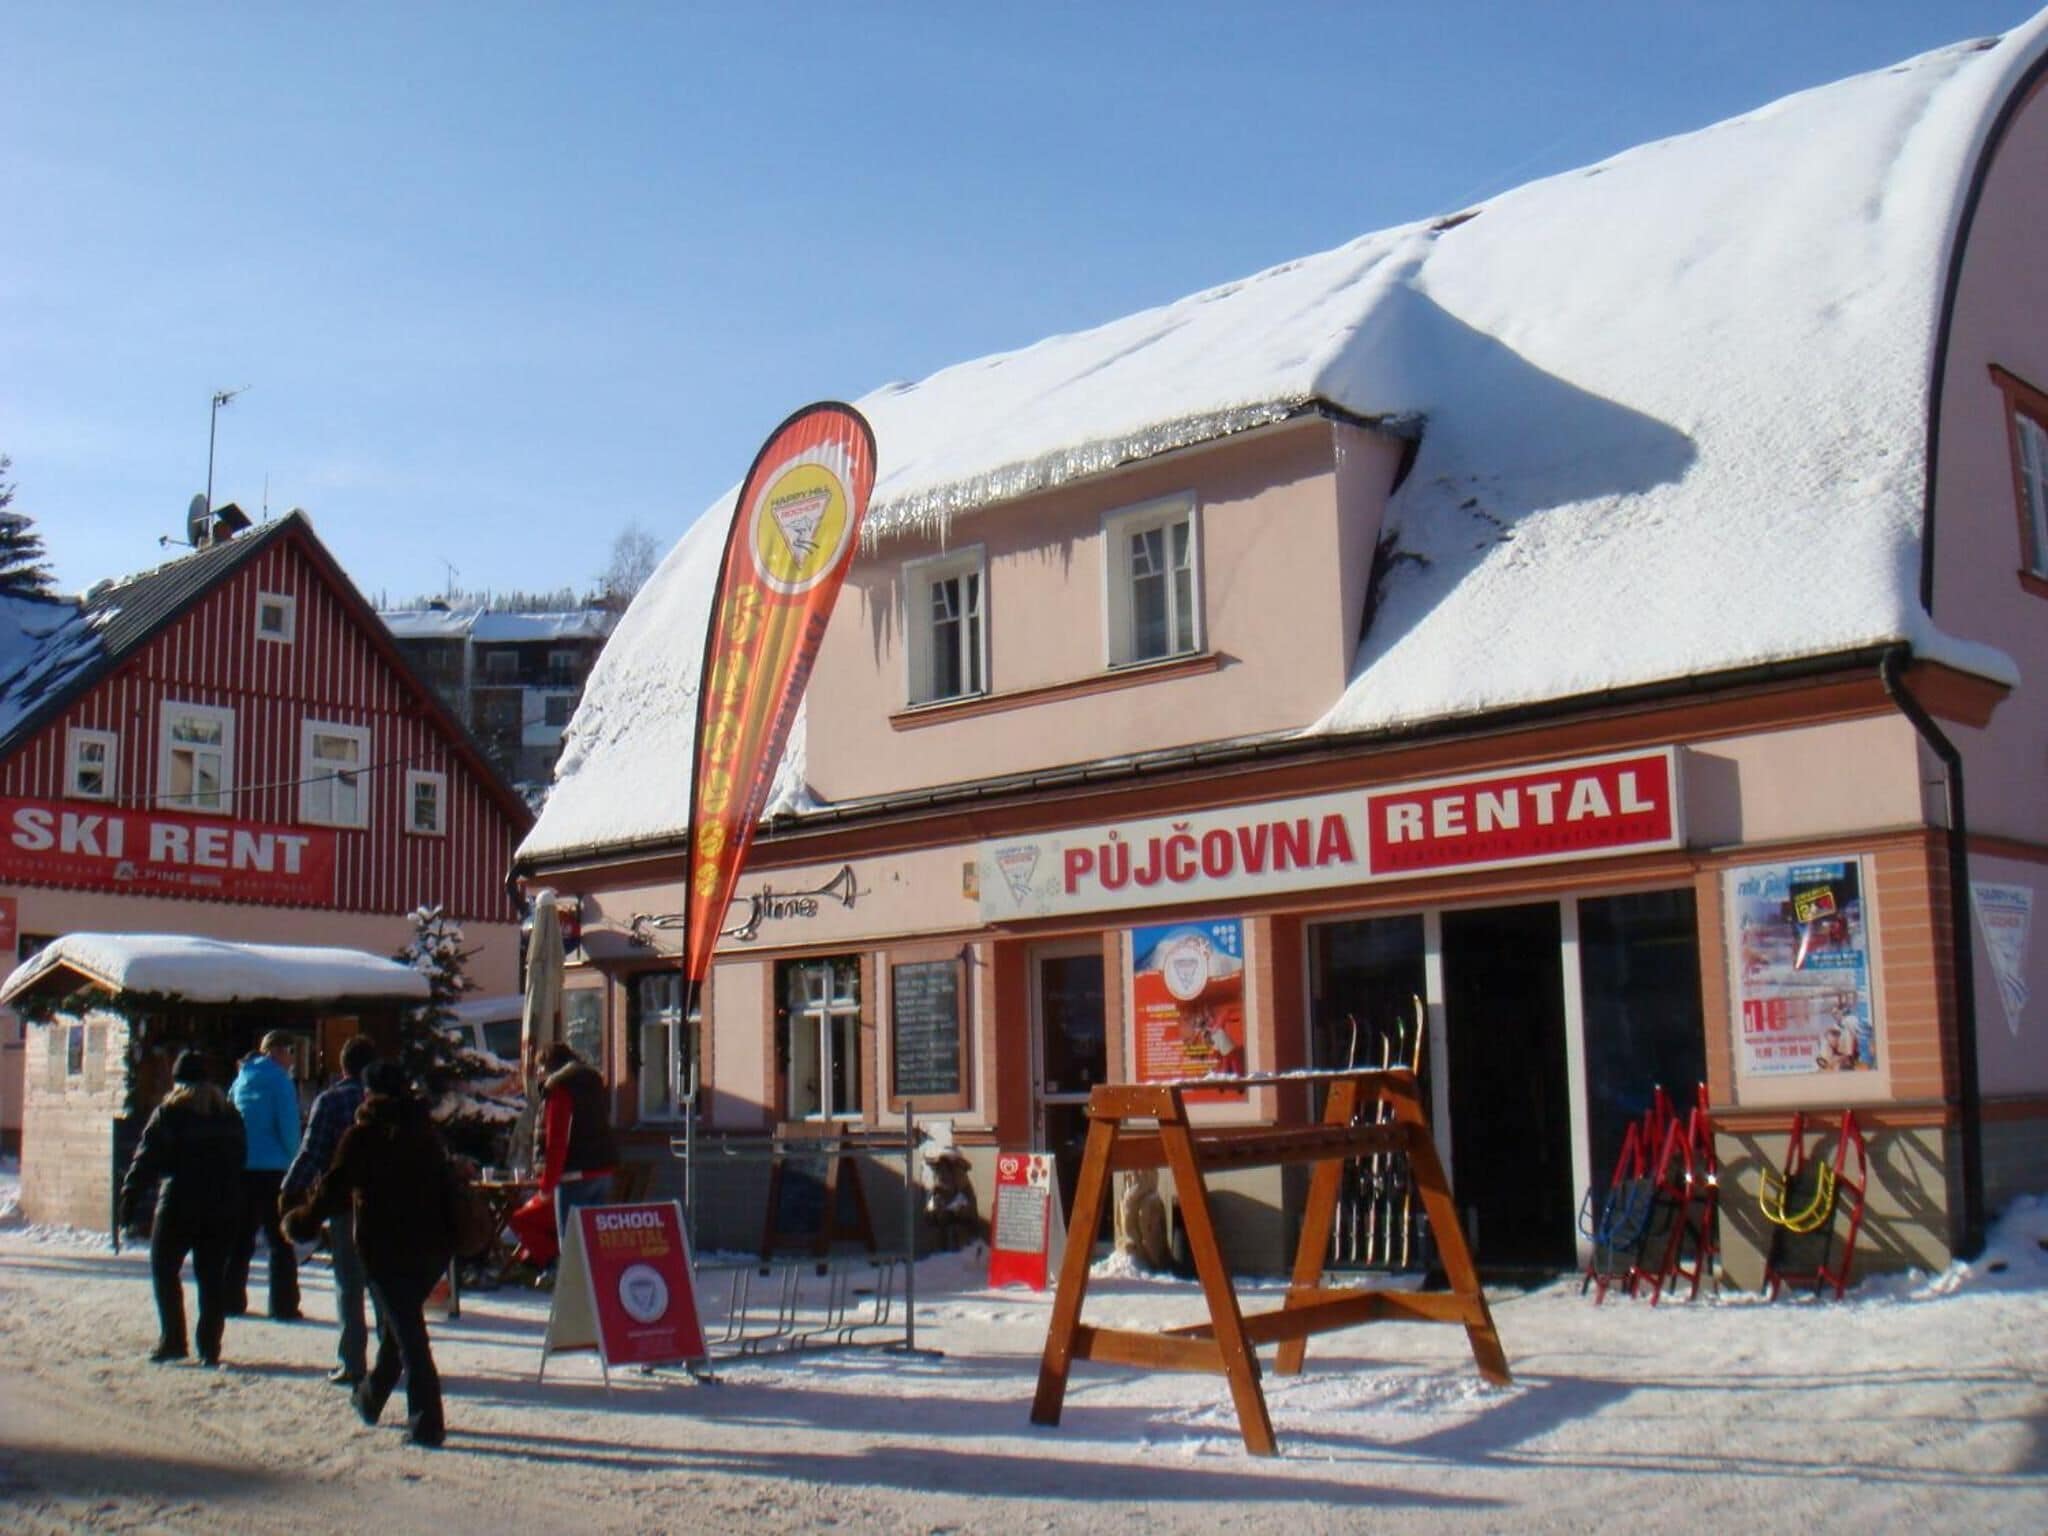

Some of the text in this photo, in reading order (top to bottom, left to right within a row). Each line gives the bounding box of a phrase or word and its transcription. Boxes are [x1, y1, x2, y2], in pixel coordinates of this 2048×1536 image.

[11, 808, 310, 875] SKI RENT
[1385, 772, 1656, 844] RENTAL
[1063, 813, 1353, 893] PŮJČOVNA
[596, 1211, 664, 1230] SCHOOL
